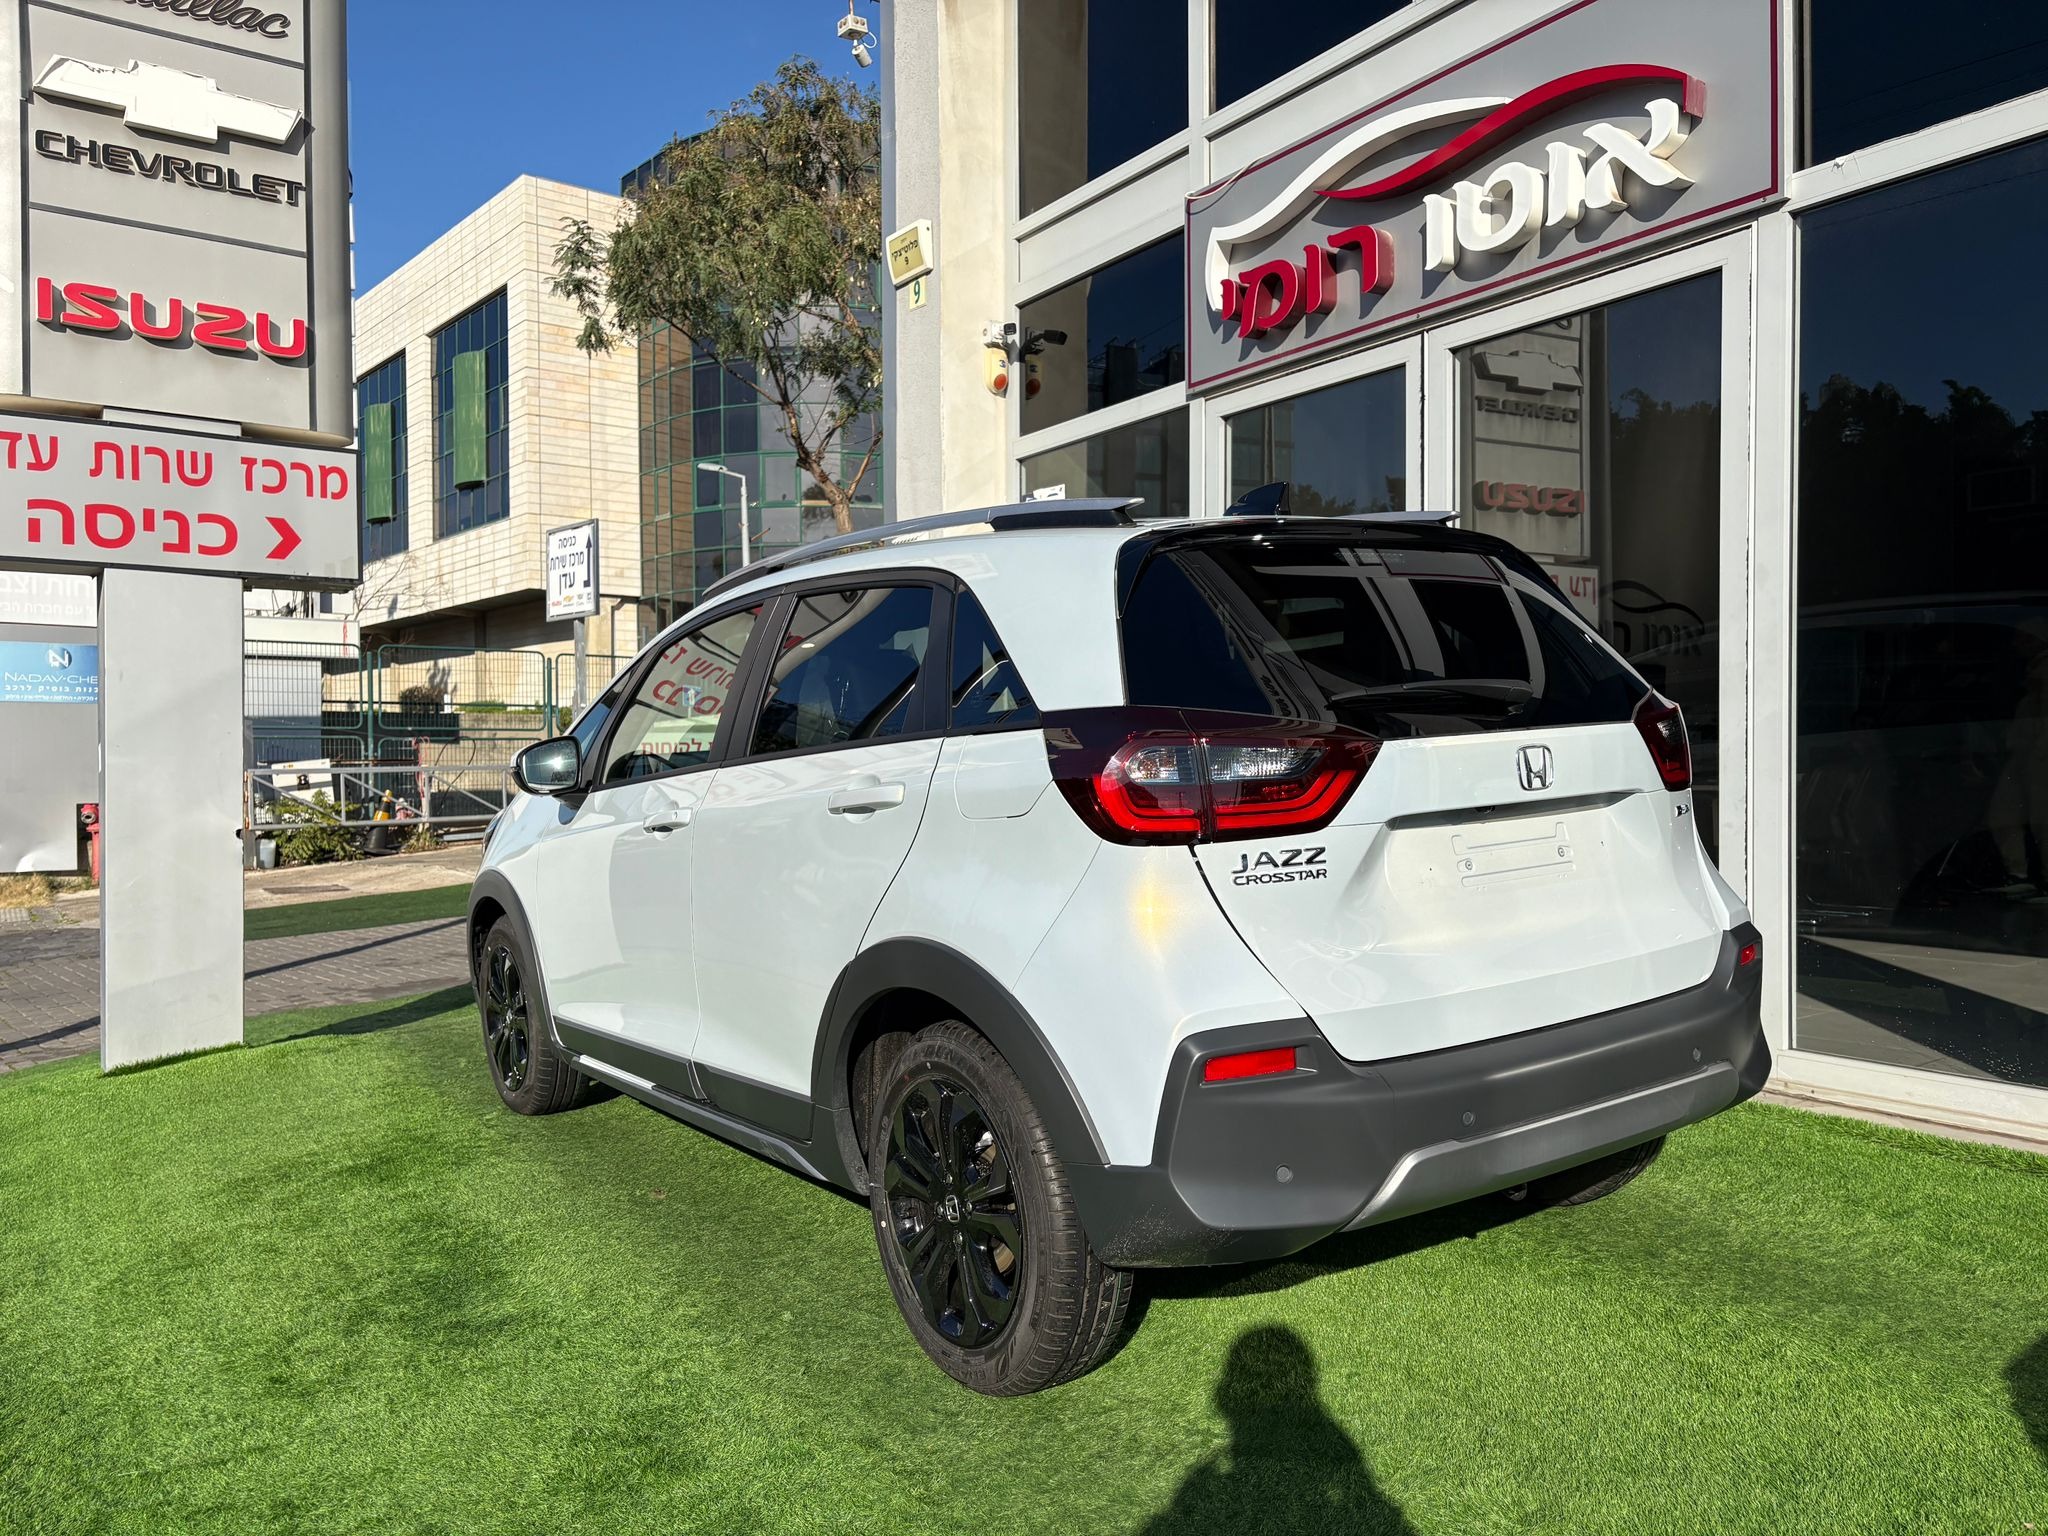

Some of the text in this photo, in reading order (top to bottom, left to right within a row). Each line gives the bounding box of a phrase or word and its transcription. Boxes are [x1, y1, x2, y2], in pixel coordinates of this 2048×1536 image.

[34, 129, 307, 204] CHEVROLET
[1219, 97, 1696, 340] אוטו רומי
[913, 280, 920, 304] 9
[36, 276, 307, 359] ISUZU
[89, 441, 213, 487] שרות
[240, 455, 349, 500] מרכז
[27, 498, 239, 556] כניסה
[558, 535, 577, 550] כניסה
[568, 551, 584, 567] מרכז
[559, 571, 576, 596] עדן
[1231, 846, 1327, 874] JAZZ
[1233, 868, 1328, 886] CROSSTAR
